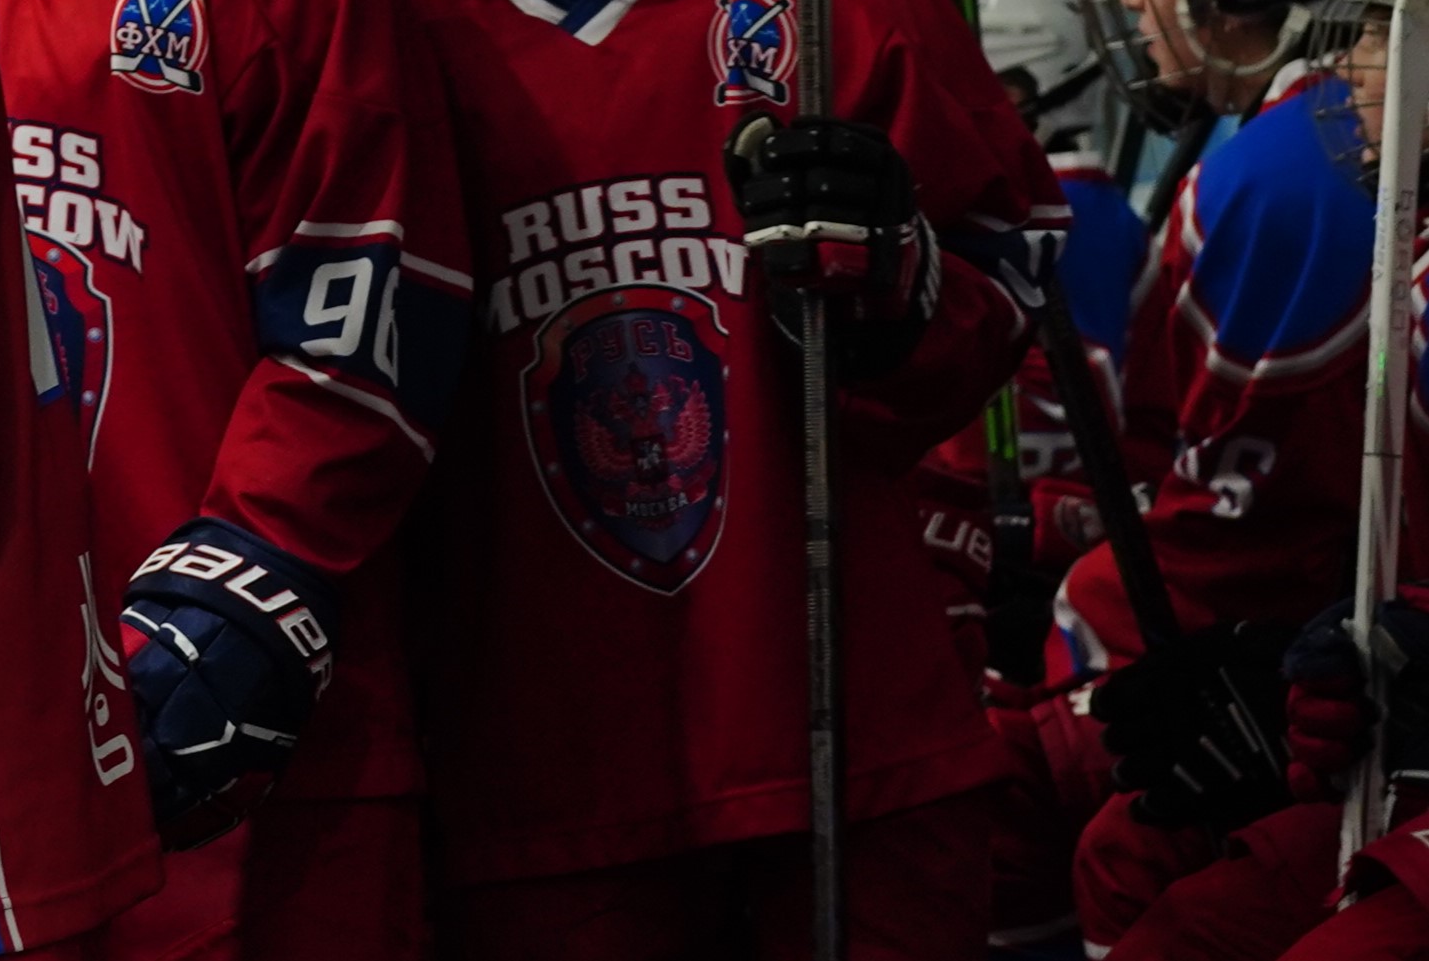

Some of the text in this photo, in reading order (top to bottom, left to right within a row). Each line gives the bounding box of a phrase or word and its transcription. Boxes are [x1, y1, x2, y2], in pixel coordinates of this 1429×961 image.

[116, 21, 191, 64] ФХМ
[12, 124, 101, 190] SS
[501, 177, 712, 264] RUSS
[127, 540, 335, 704] BAUER
